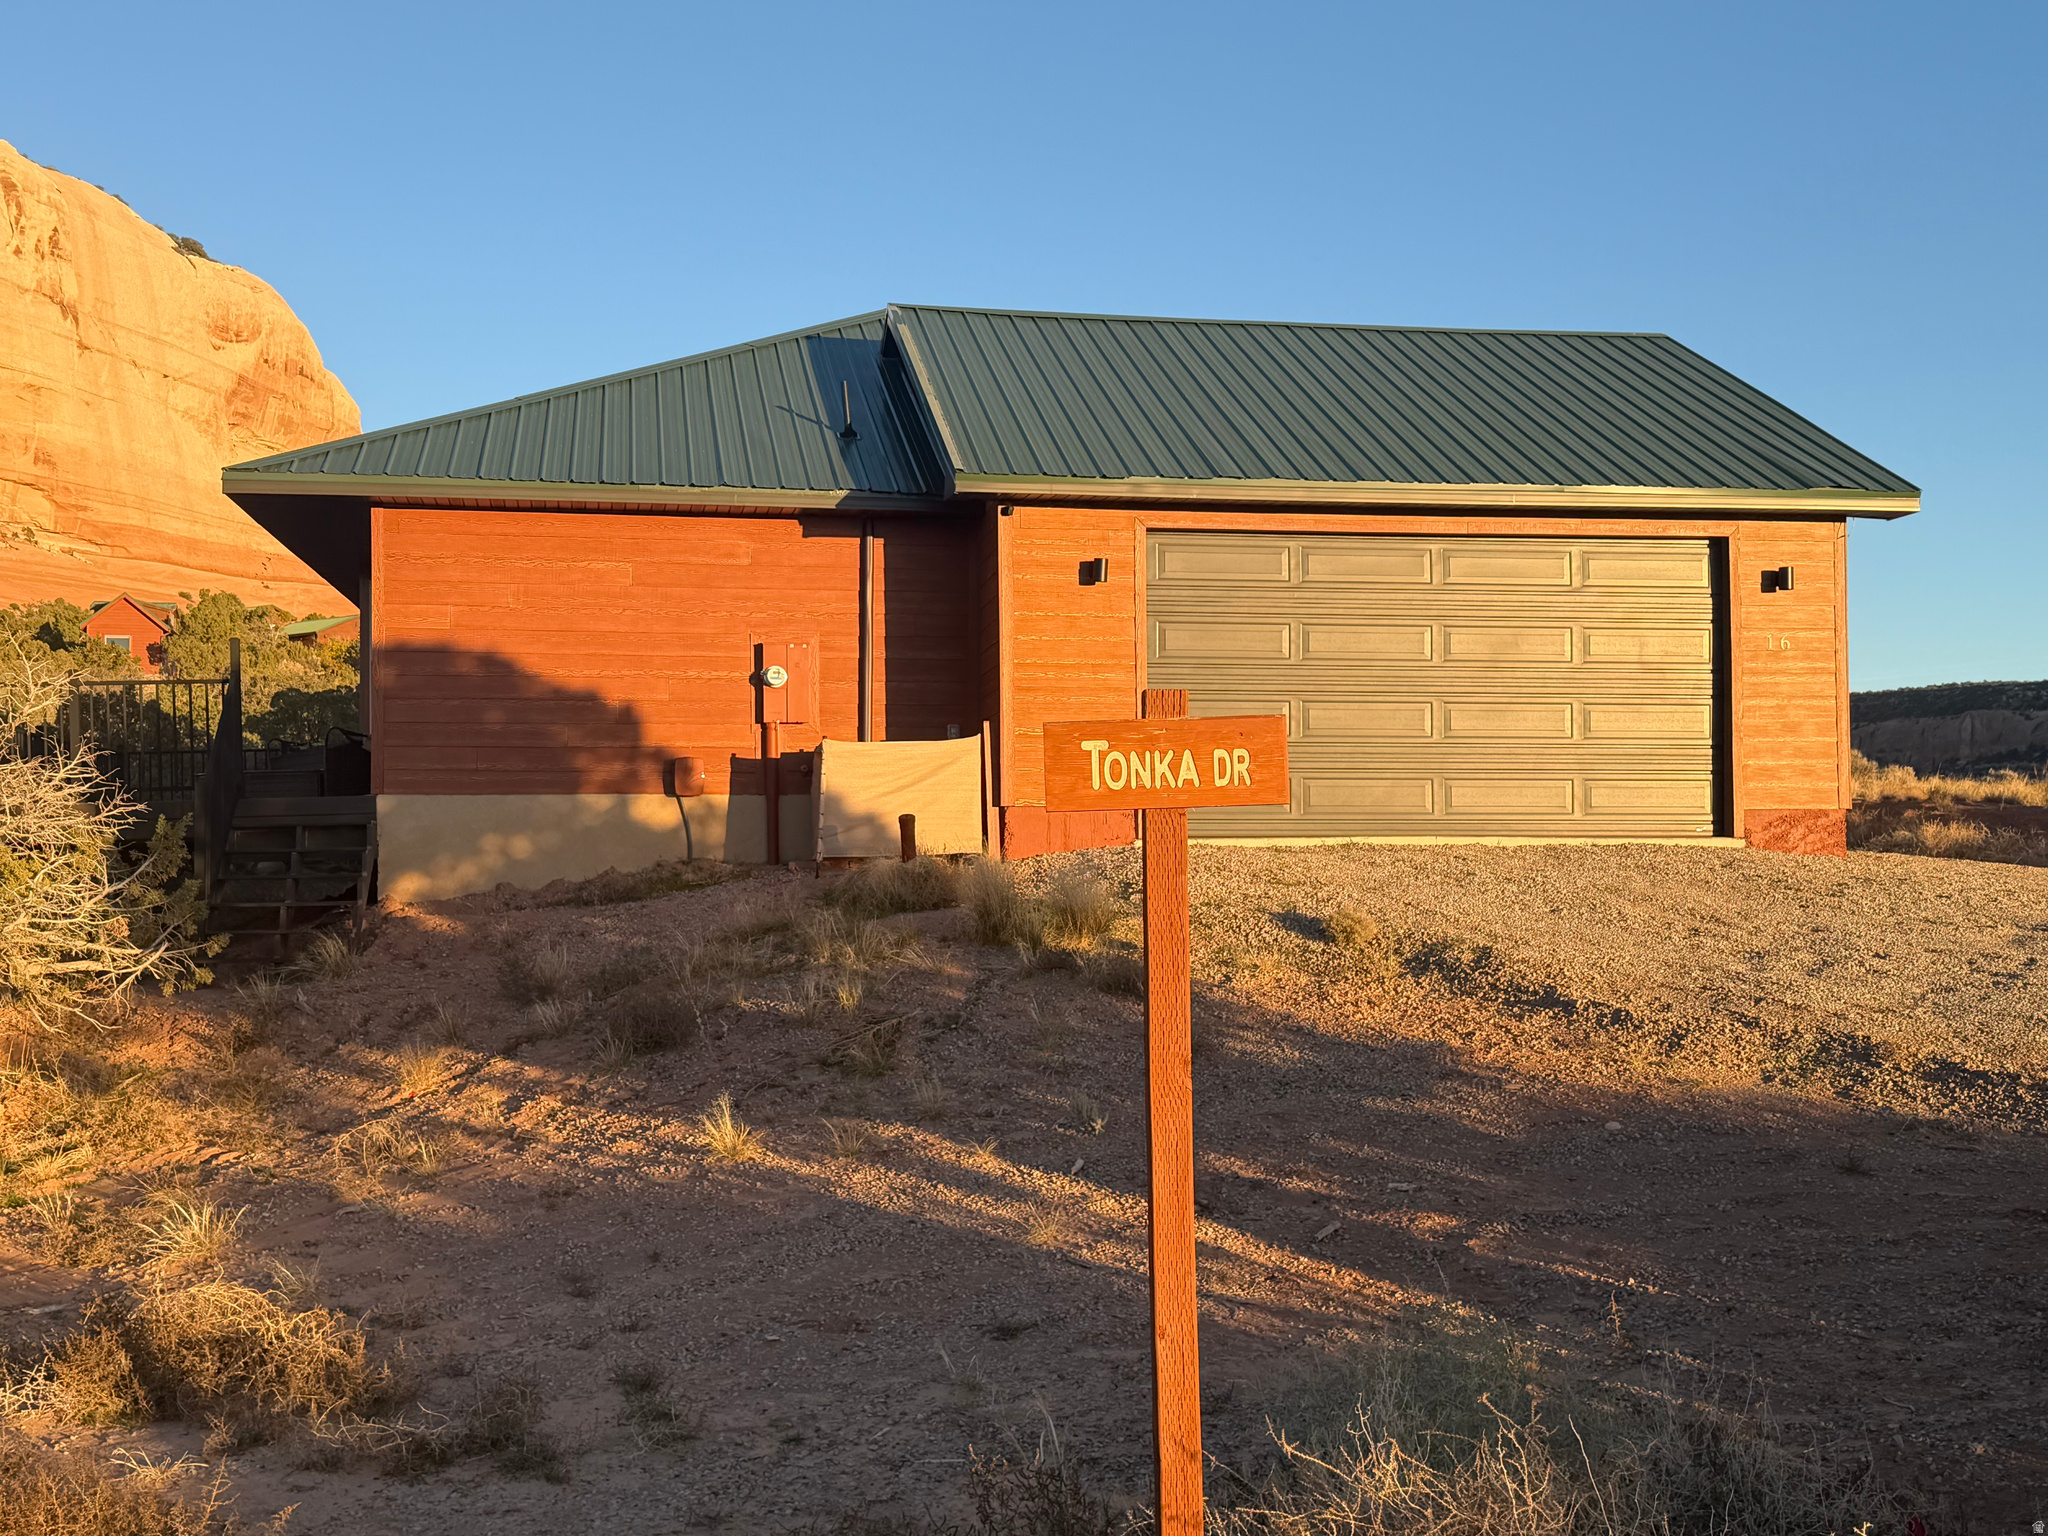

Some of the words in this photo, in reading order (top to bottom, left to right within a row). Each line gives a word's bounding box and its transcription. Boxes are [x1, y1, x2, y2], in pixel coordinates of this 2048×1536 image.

[1766, 634, 1791, 651] 16
[1081, 740, 1200, 790] TONKA
[1213, 748, 1251, 787] DR
